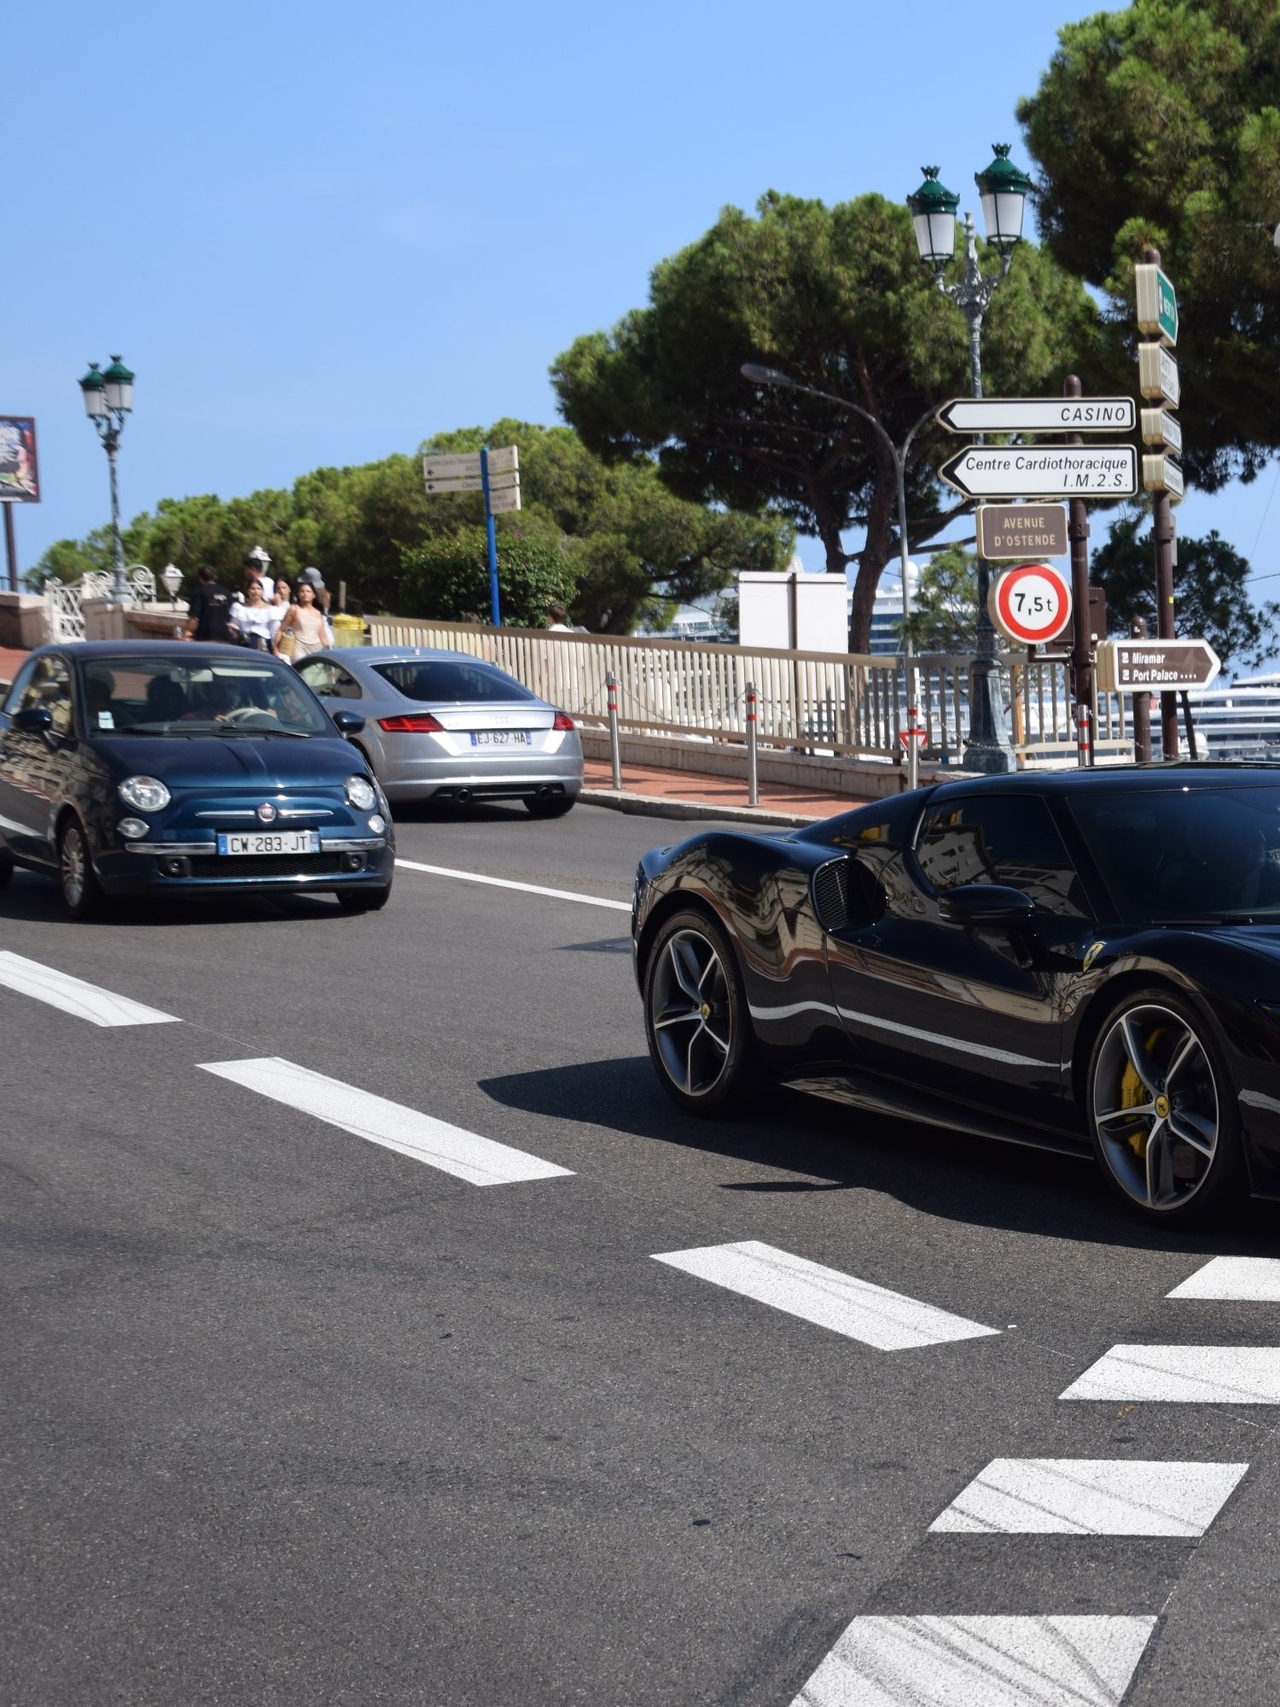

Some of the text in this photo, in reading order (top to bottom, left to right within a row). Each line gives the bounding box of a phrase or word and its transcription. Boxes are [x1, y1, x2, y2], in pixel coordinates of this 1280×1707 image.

[1060, 407, 1126, 422] CASINO
[965, 456, 1128, 473] Centre Cardiothoracique
[1063, 474, 1128, 488] I.M.2.S.
[1003, 517, 1045, 529] AVENUE
[994, 534, 1056, 547] D'OSTENDE
[1132, 652, 1166, 664] Miramar
[1132, 668, 1178, 682] Port Palace
[477, 731, 526, 745] EJ-627-HA
[230, 836, 308, 853] CW-283-JT
